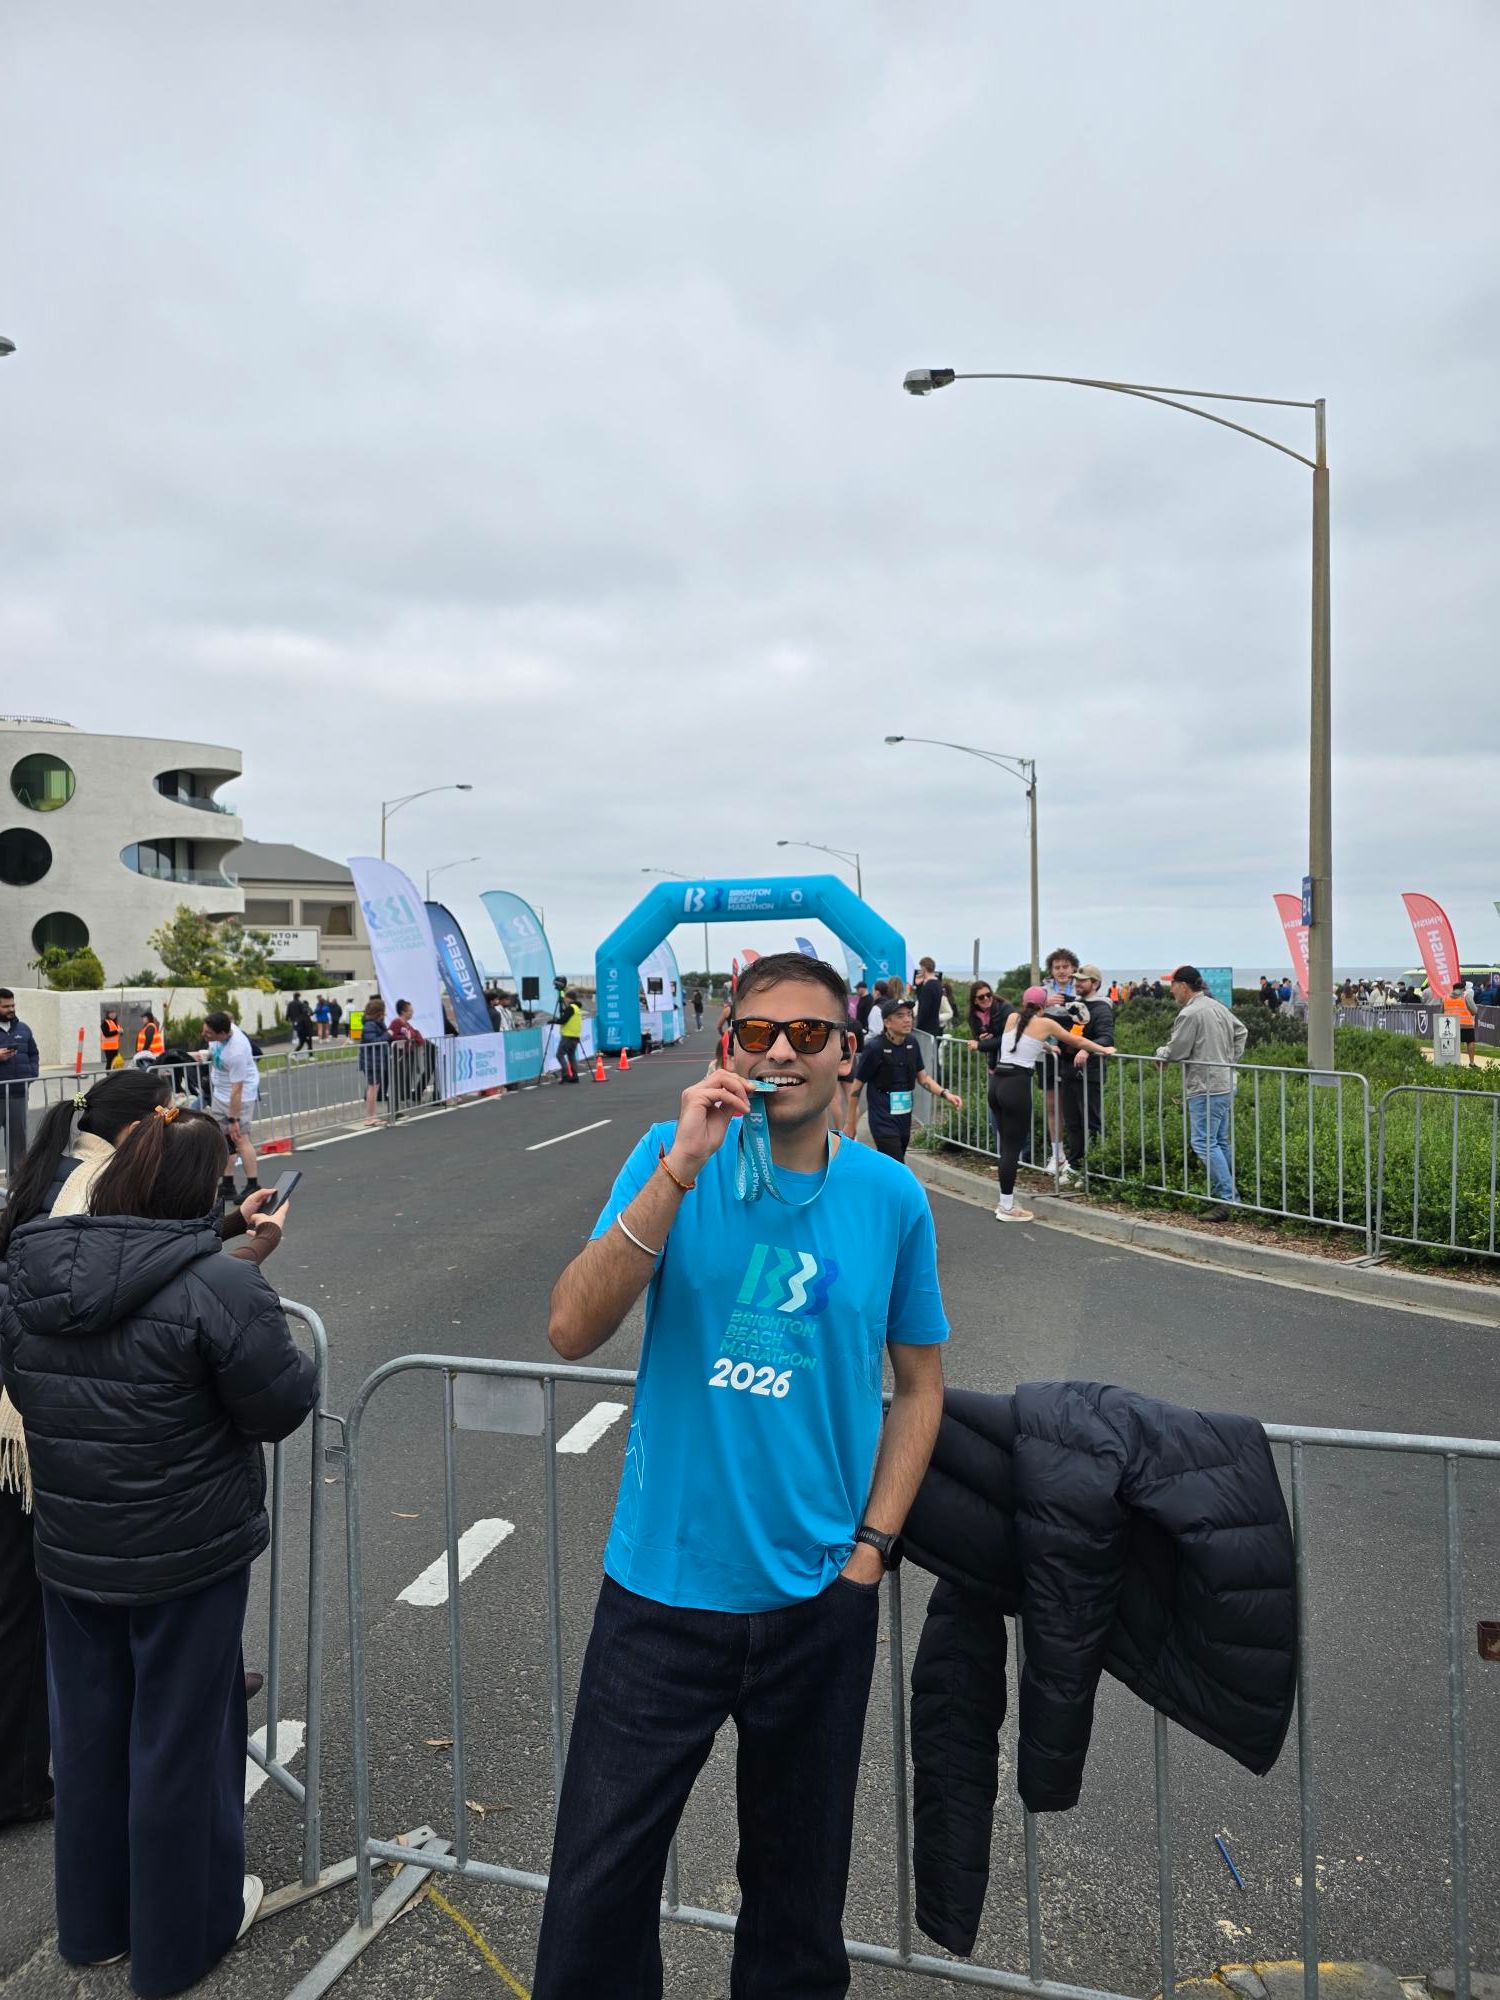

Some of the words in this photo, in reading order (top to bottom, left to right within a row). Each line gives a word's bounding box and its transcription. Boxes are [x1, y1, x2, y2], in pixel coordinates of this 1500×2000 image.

[728, 896, 756, 904] BEACH
[729, 888, 771, 896] BRIGHTON
[728, 903, 774, 911] MARATHON
[730, 1309, 817, 1338] BRIGHTON
[724, 1324, 784, 1347] BEACH
[719, 1339, 817, 1369] MARATHON
[708, 1357, 793, 1398] 2026
